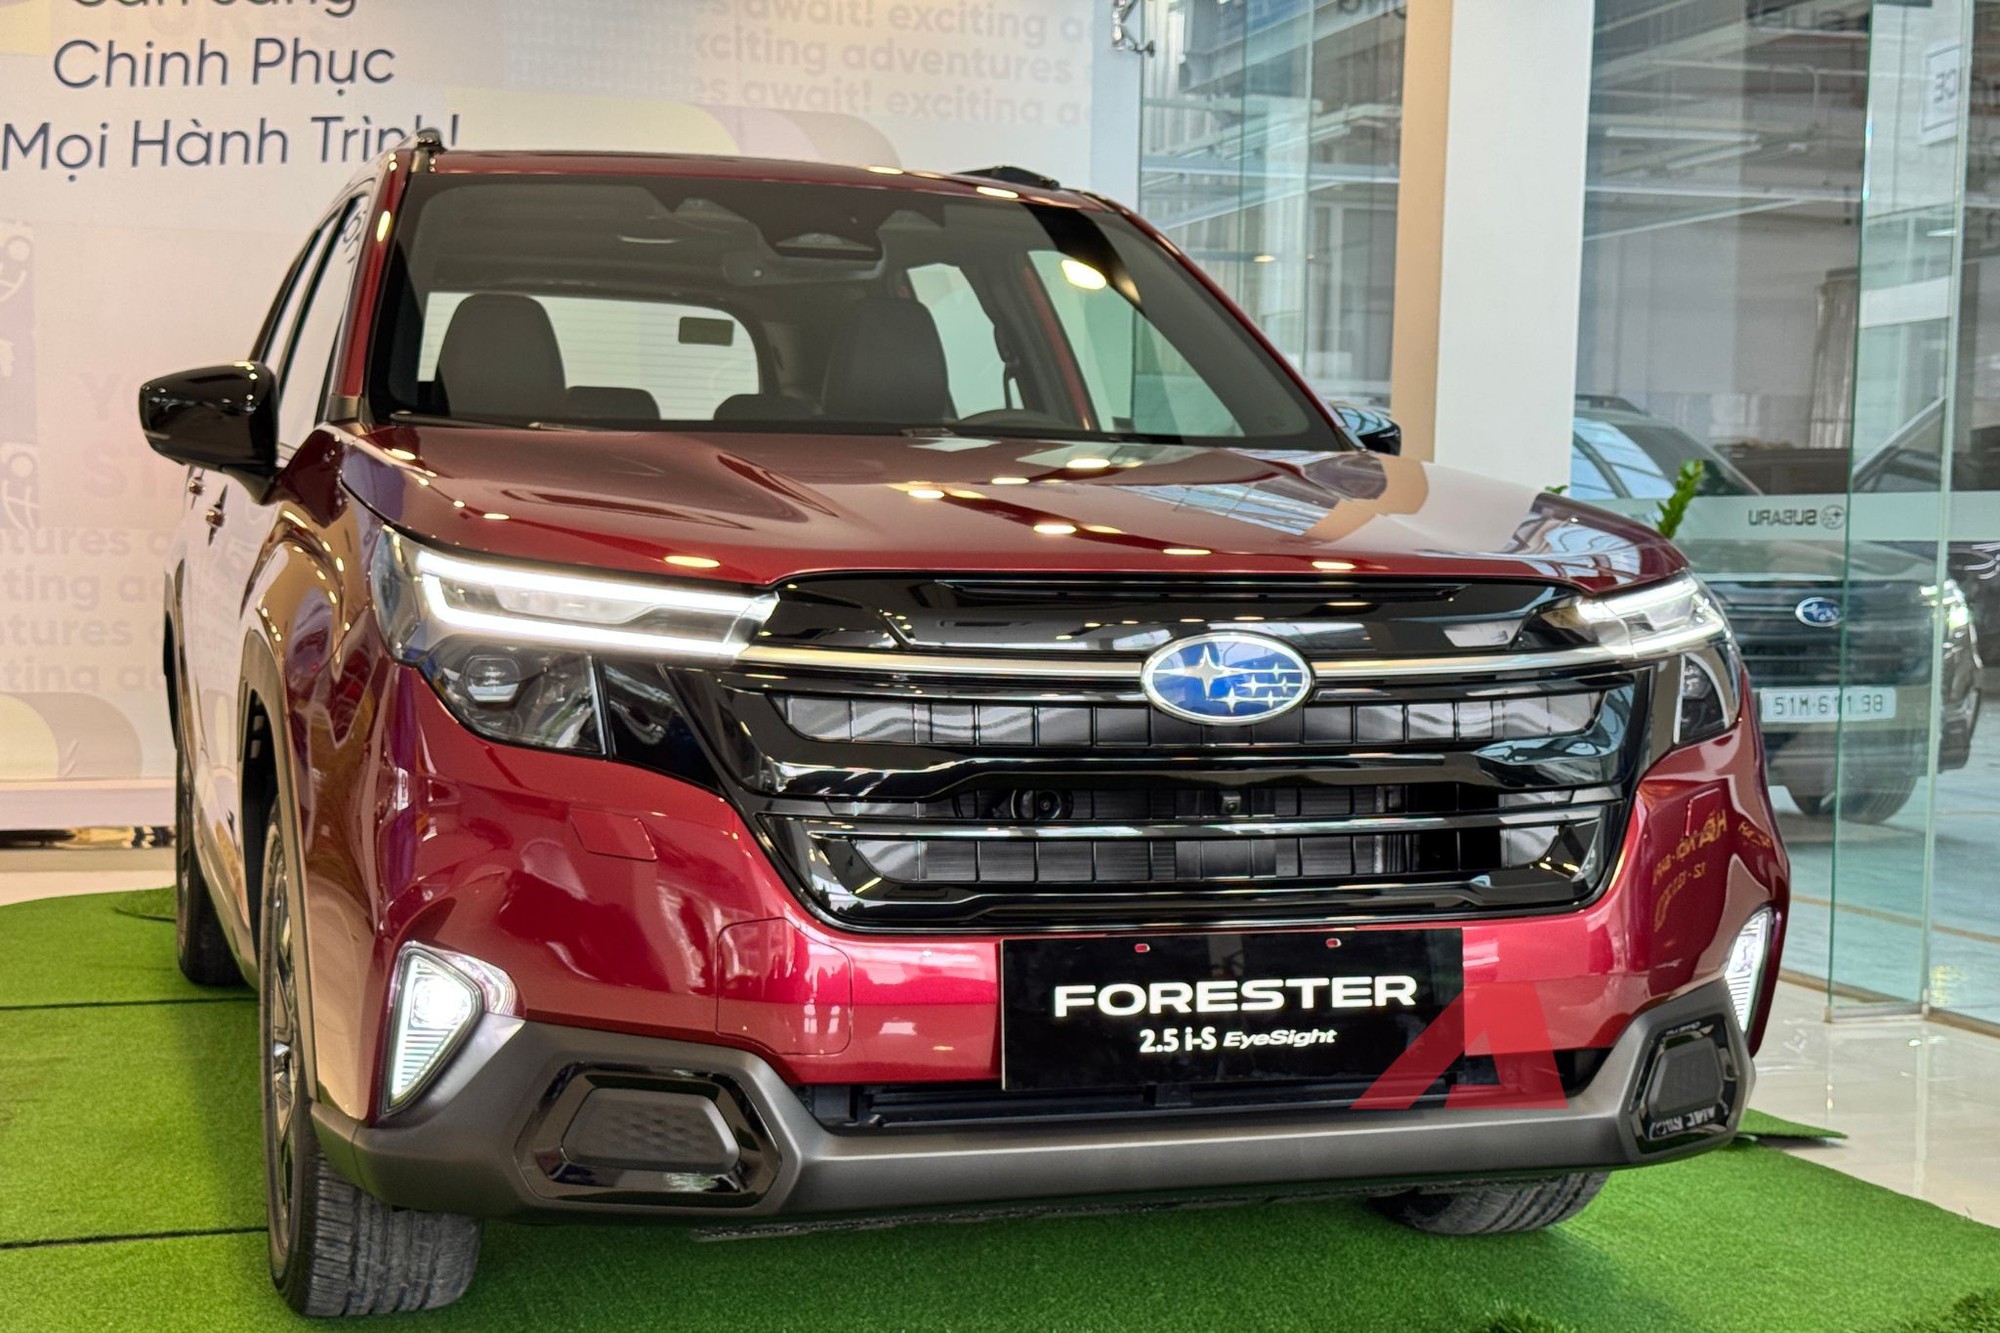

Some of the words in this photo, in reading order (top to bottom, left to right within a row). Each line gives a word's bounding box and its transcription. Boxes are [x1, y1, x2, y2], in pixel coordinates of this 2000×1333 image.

[54, 38, 229, 89] Chinh
[252, 36, 396, 97] Phục
[841, 38, 1075, 84] adventures
[1, 121, 109, 182] Mọi
[131, 117, 289, 168] Hành
[310, 113, 460, 163] Trìn!
[1054, 975, 1418, 1018] FORESTER
[1139, 1028, 1180, 1053] 2.5
[1222, 1028, 1338, 1050] EyeSight
